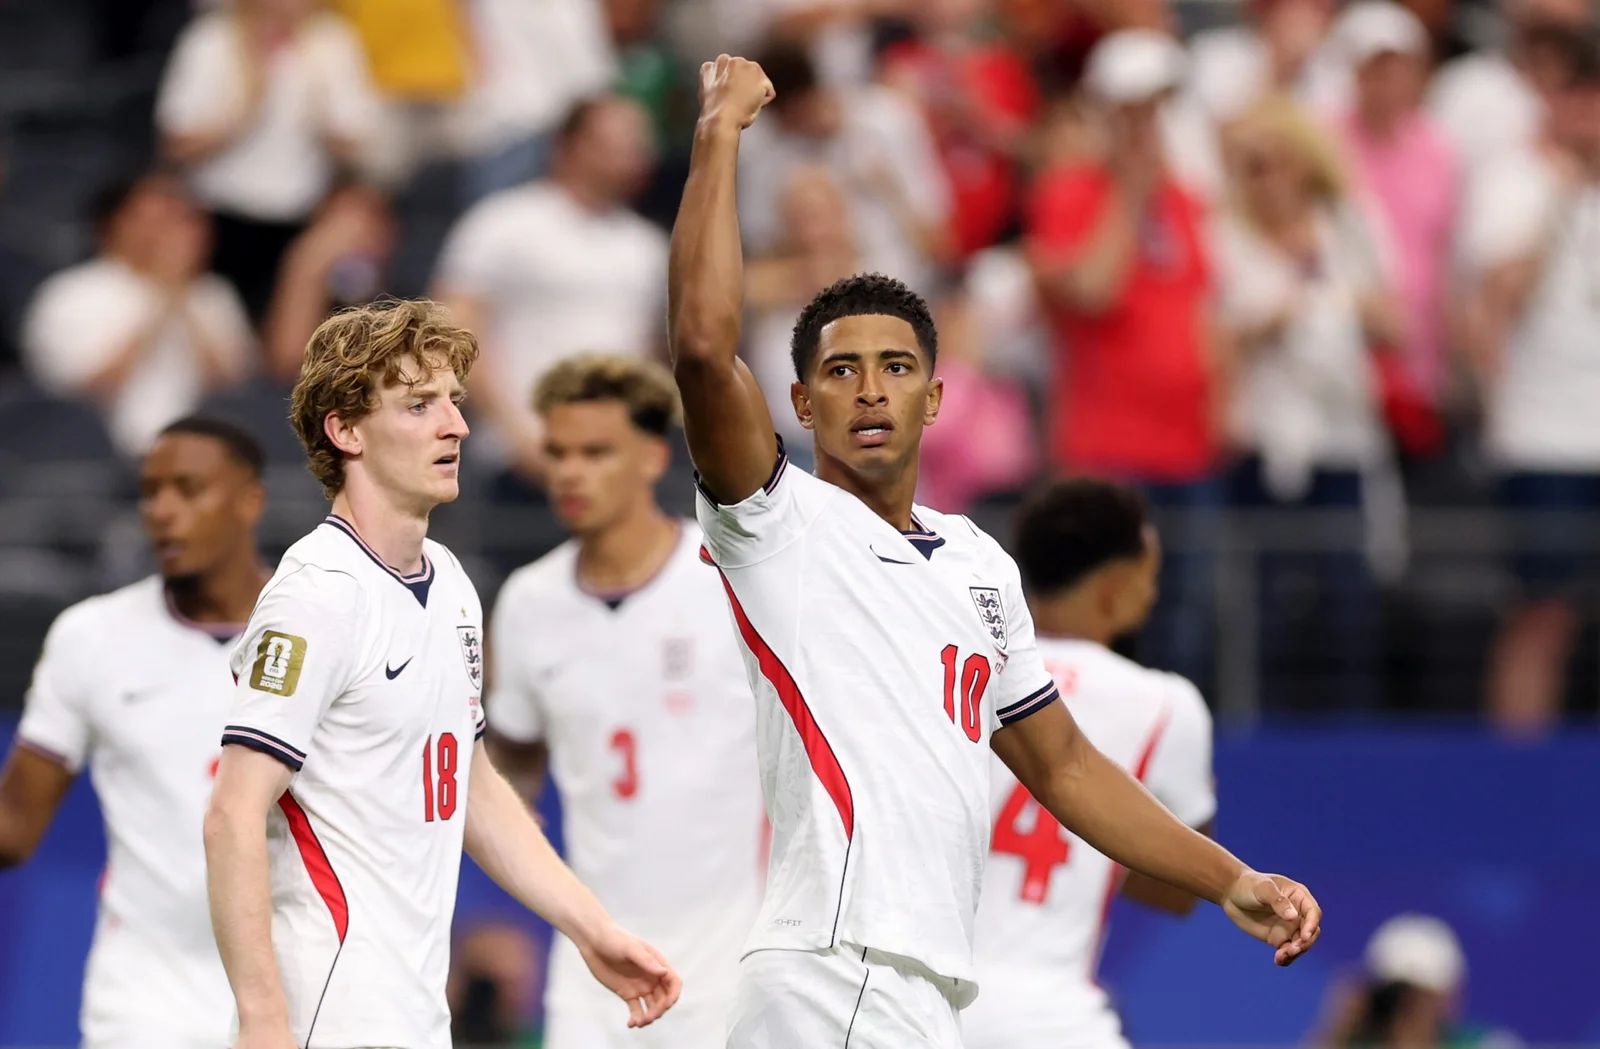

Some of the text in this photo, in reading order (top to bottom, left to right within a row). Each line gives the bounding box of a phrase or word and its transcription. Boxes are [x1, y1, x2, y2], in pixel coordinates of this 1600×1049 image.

[259, 680, 283, 690] 2026
[941, 643, 991, 743] 10
[423, 732, 457, 822] 18
[610, 729, 638, 801] 3
[992, 778, 1070, 904] 4
